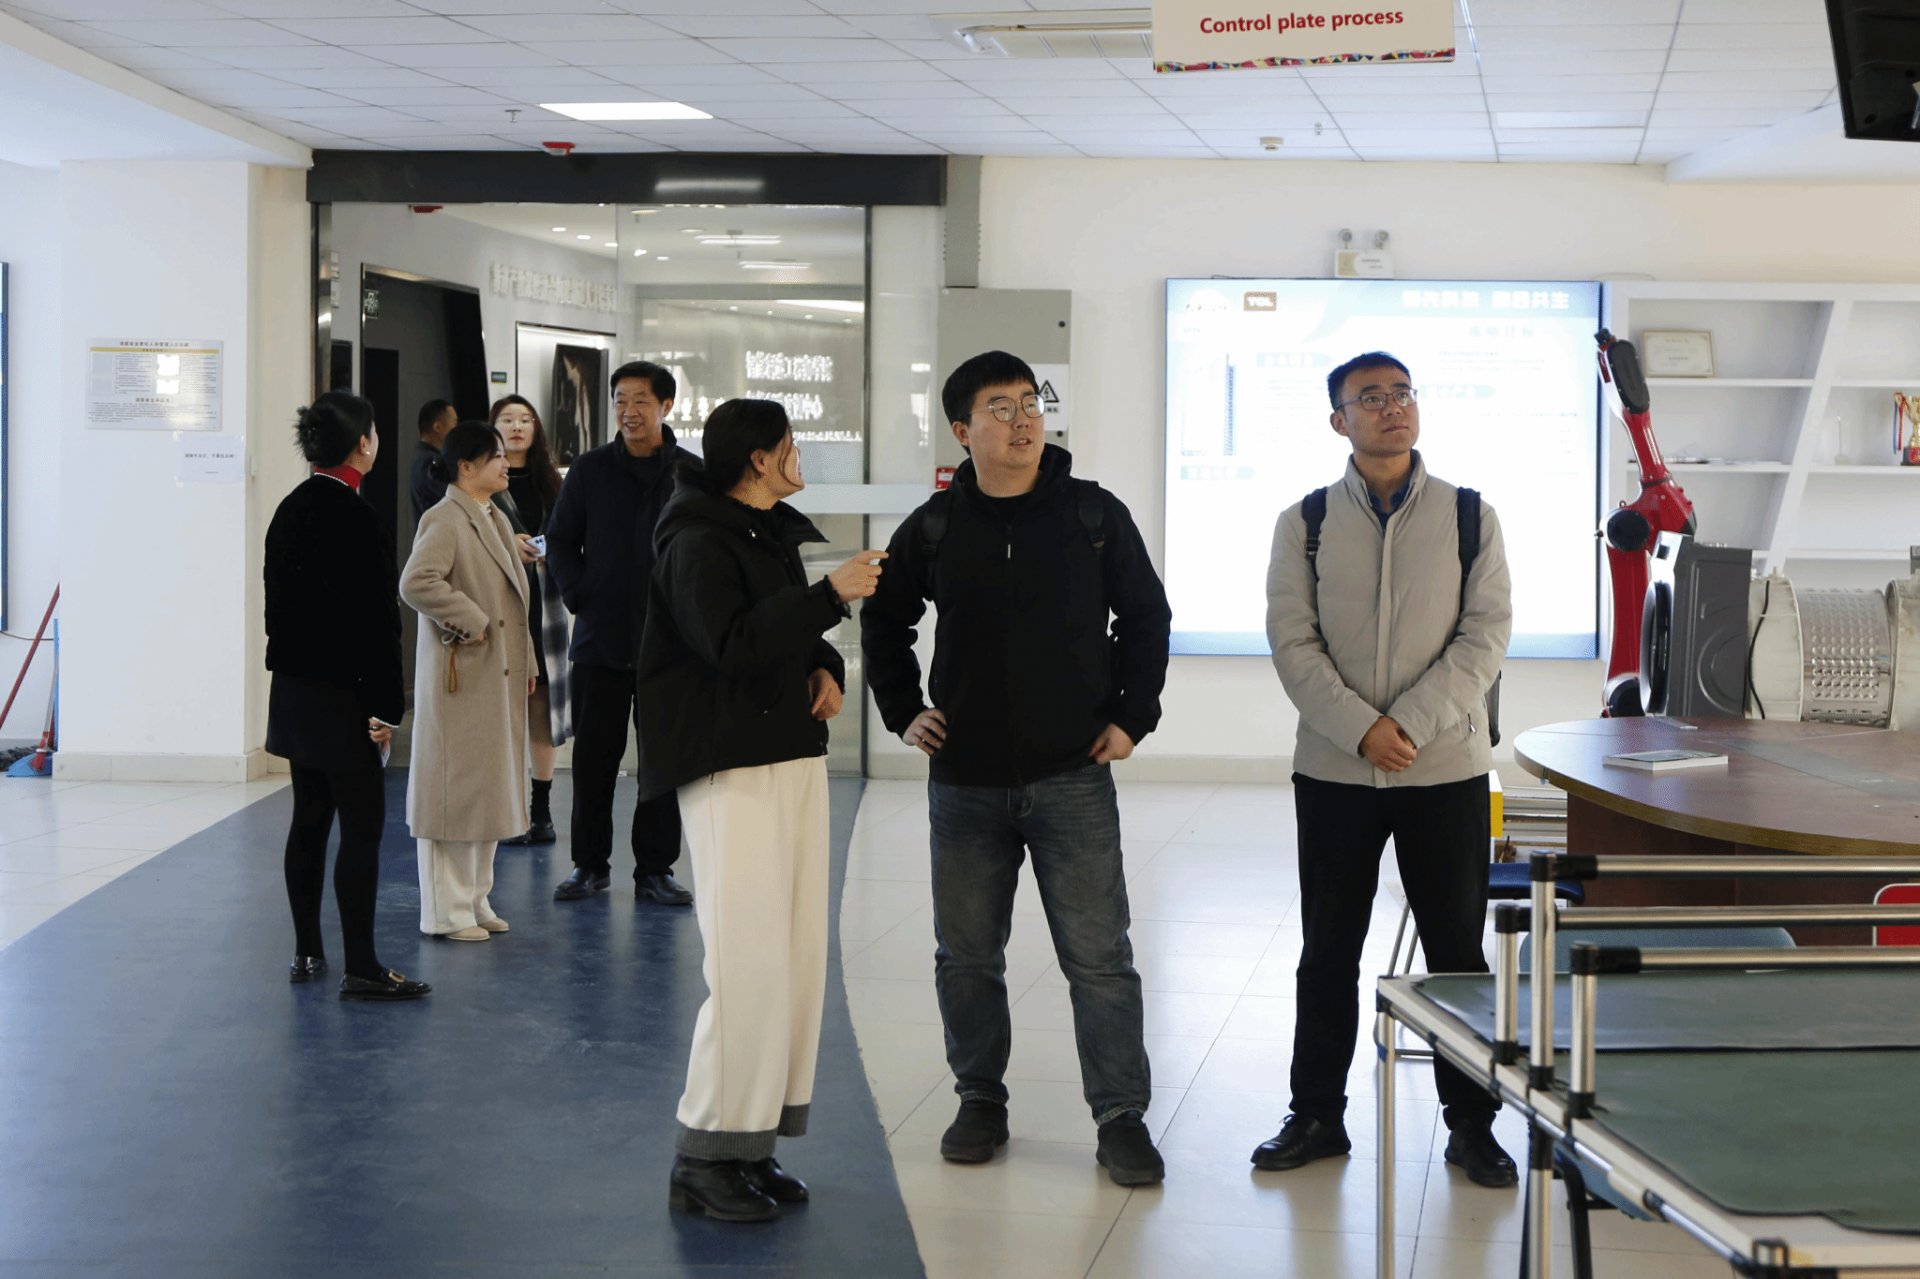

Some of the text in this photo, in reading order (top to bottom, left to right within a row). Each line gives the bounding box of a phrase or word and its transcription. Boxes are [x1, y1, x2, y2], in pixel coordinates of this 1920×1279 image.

[1199, 9, 1405, 34] Control plate process
[1246, 296, 1274, 307] TCL
